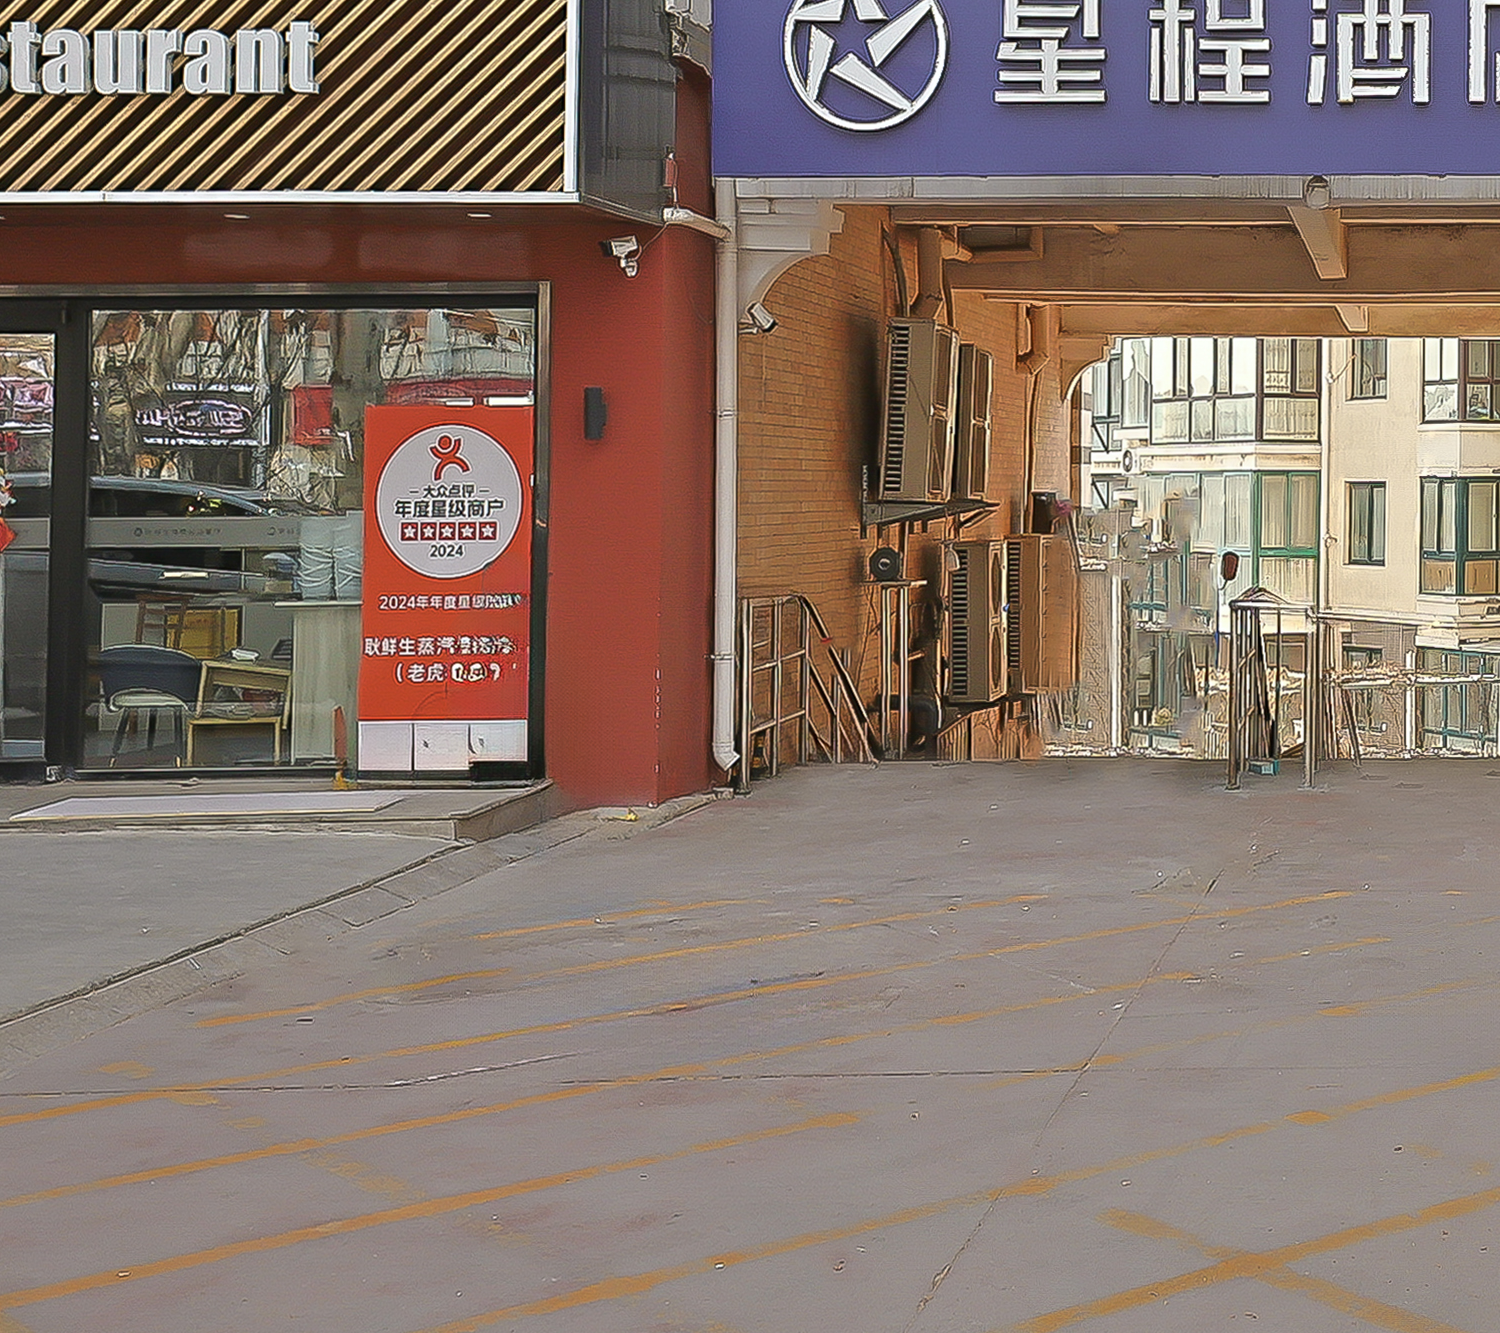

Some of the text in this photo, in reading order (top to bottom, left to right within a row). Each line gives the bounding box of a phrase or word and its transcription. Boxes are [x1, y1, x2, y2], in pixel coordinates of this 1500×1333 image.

[422, 483, 476, 499] 大众点评
[394, 499, 505, 518] 年度星级商户
[429, 544, 464, 558] 2024
